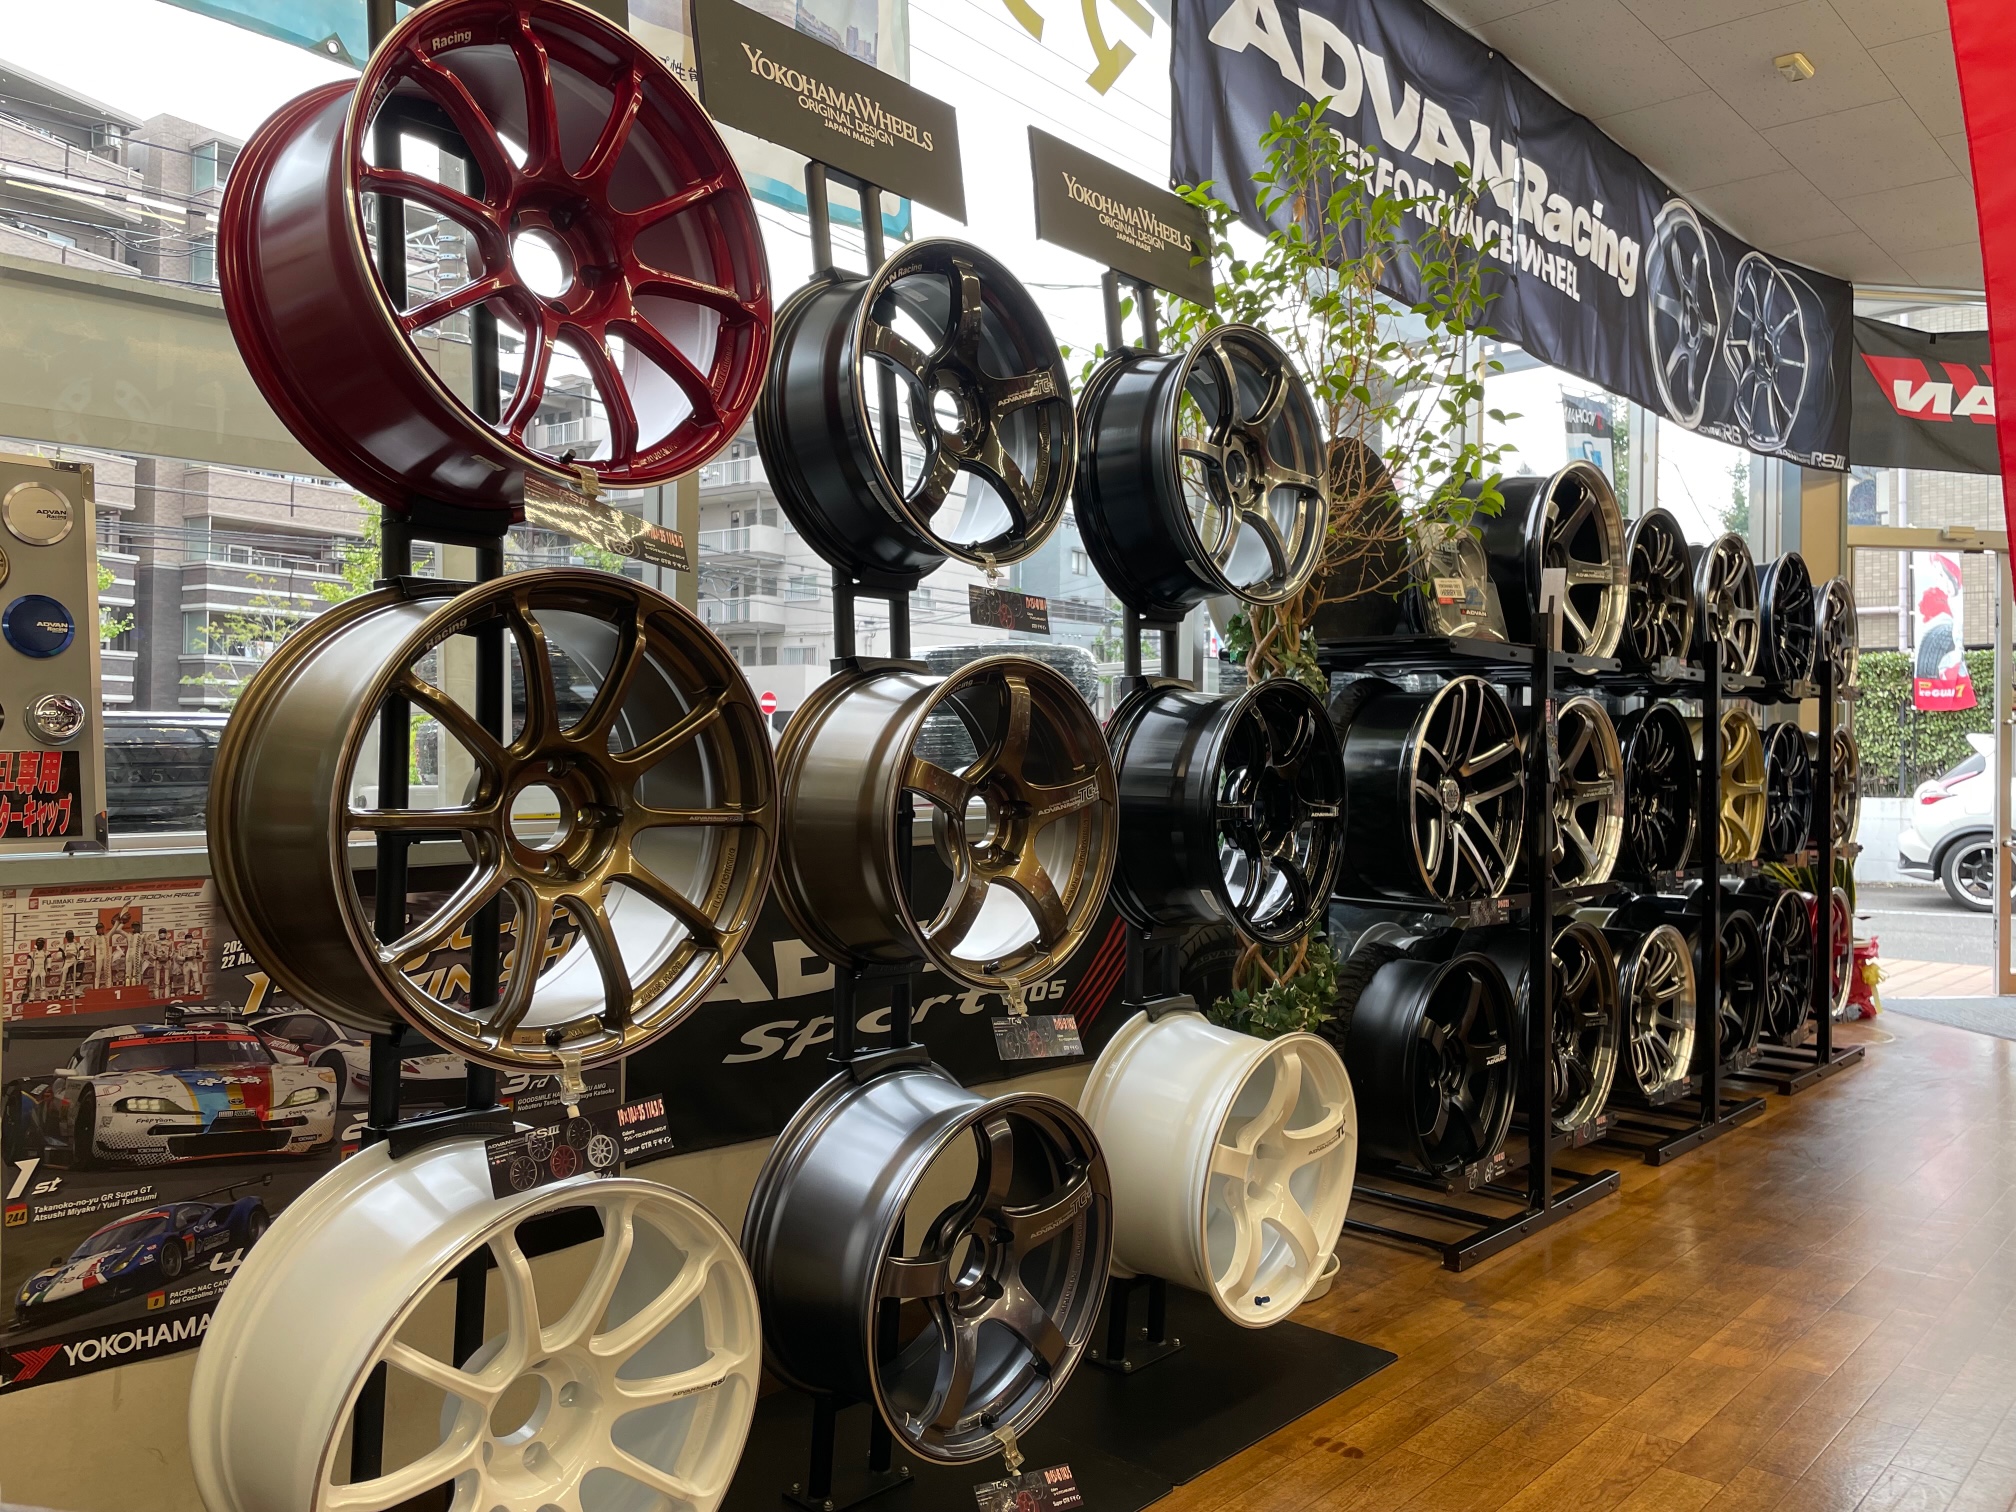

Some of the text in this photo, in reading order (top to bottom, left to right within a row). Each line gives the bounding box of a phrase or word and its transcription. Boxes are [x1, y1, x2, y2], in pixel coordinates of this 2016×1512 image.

[432, 30, 472, 50] Racing
[798, 95, 895, 147] ORIGINAL DESIGN
[824, 118, 875, 147] JAPAN MADE
[1098, 213, 1165, 251] ORIGINAL DESIGN
[1518, 158, 1640, 297] Racing
[1116, 232, 1152, 253] JAPAN MADE
[898, 263, 922, 277] Racing
[1519, 233, 1581, 302] WHEEL
[1466, 609, 1487, 617] ADVAN
[425, 618, 468, 650] Racing
[1038, 801, 1068, 816] ADVAN
[42, 898, 75, 906] FUJIMAKI
[76, 896, 122, 904] SUZUKA
[173, 891, 202, 899] RACE
[222, 940, 246, 955] 202
[221, 954, 236, 969] 22
[114, 989, 121, 999] 1
[46, 1003, 61, 1015] 2
[500, 1071, 550, 1095] 3rd
[517, 1092, 552, 1106] GOODSMILE
[593, 1082, 607, 1090] AMG
[517, 1099, 544, 1112] Nobuteru
[593, 1087, 615, 1096] Kataoka
[487, 1139, 511, 1150] ADVAN
[623, 1145, 640, 1155] Super
[640, 1141, 652, 1150] GTR
[6, 1157, 62, 1200] 1st
[33, 1208, 66, 1222] Atsushi
[67, 1204, 96, 1217] Miyake
[102, 1200, 120, 1210] Yuui
[121, 1192, 157, 1207] Tsutsumi
[34, 1186, 152, 1214] Takanoko-no-yu GR Supra GT
[6, 1211, 26, 1224] 244
[1030, 1221, 1060, 1239] ADVAN
[169, 1287, 197, 1299] PACIFIC
[197, 1283, 212, 1293] NAC
[169, 1298, 181, 1306] Kei
[182, 1290, 214, 1303] Cozzolino
[63, 1313, 211, 1367] YOKOHAMA
[672, 1387, 696, 1397] ADVAN
